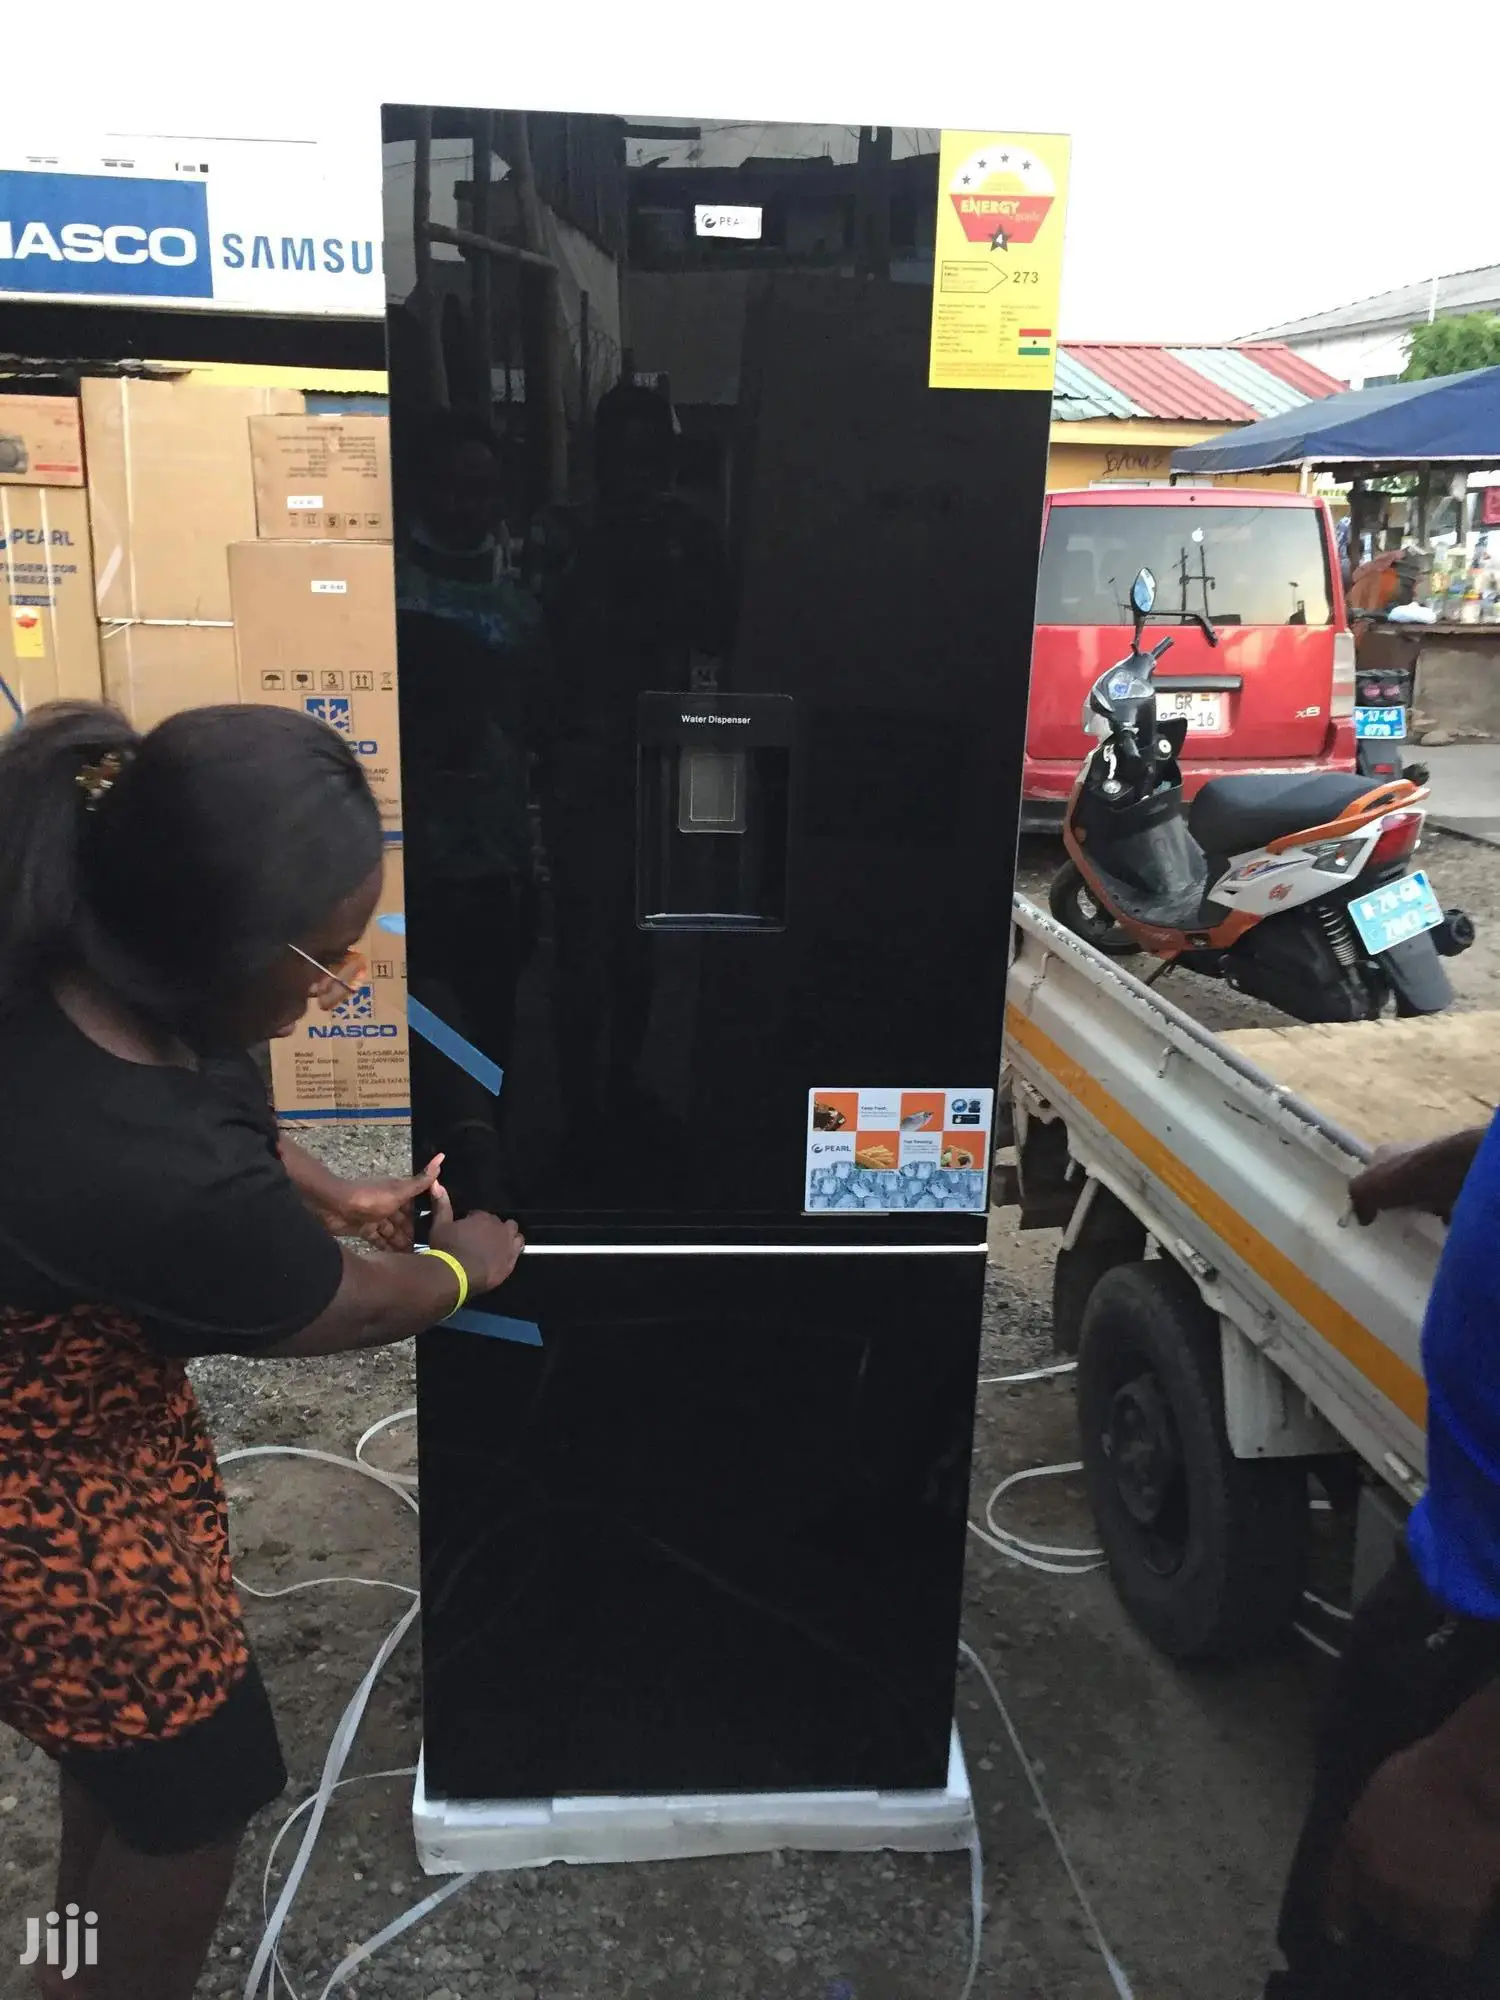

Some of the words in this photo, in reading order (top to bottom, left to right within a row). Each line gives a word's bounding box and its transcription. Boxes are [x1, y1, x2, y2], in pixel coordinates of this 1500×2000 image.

[960, 195, 1020, 216] ENERGY
[0, 220, 198, 266] ASCO
[222, 233, 384, 275] SAMSU
[1012, 271, 1039, 284] 273
[12, 528, 75, 546] PEARL
[1175, 692, 1193, 710] GR
[681, 714, 707, 724] Water
[708, 715, 751, 725] Dispenser
[1294, 706, 1321, 718] xB
[308, 1024, 398, 1039] NASCO
[824, 1144, 852, 1153] PEARL
